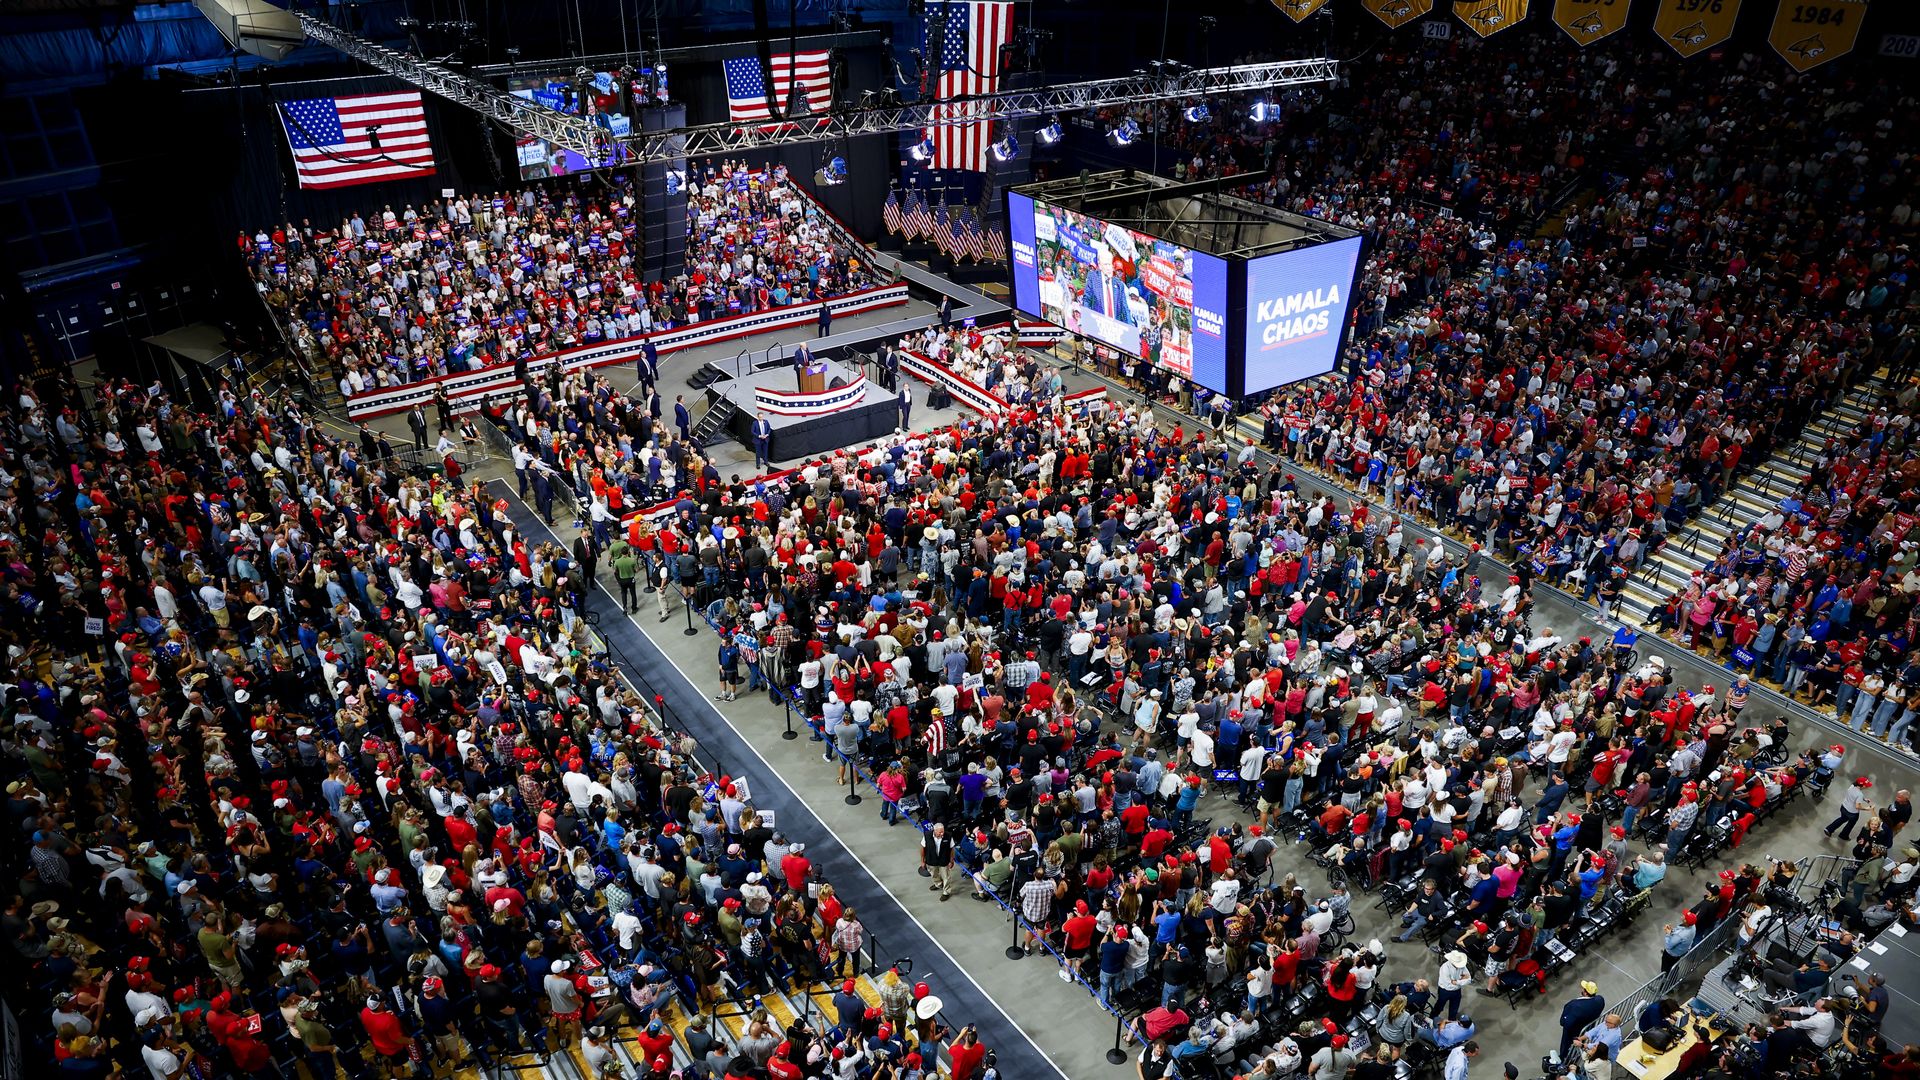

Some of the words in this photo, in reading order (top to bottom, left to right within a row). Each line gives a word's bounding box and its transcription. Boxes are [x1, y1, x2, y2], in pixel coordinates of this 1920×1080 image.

[1675, 0, 1723, 14] 1976
[1792, 5, 1844, 26] 1984
[1427, 23, 1447, 37] 210
[1884, 37, 1917, 55] 208
[1256, 284, 1340, 323] KAMALA
[1194, 306, 1223, 326] KAMALA
[1197, 319, 1221, 336] CHAOS
[1262, 310, 1330, 345] CHAOS
